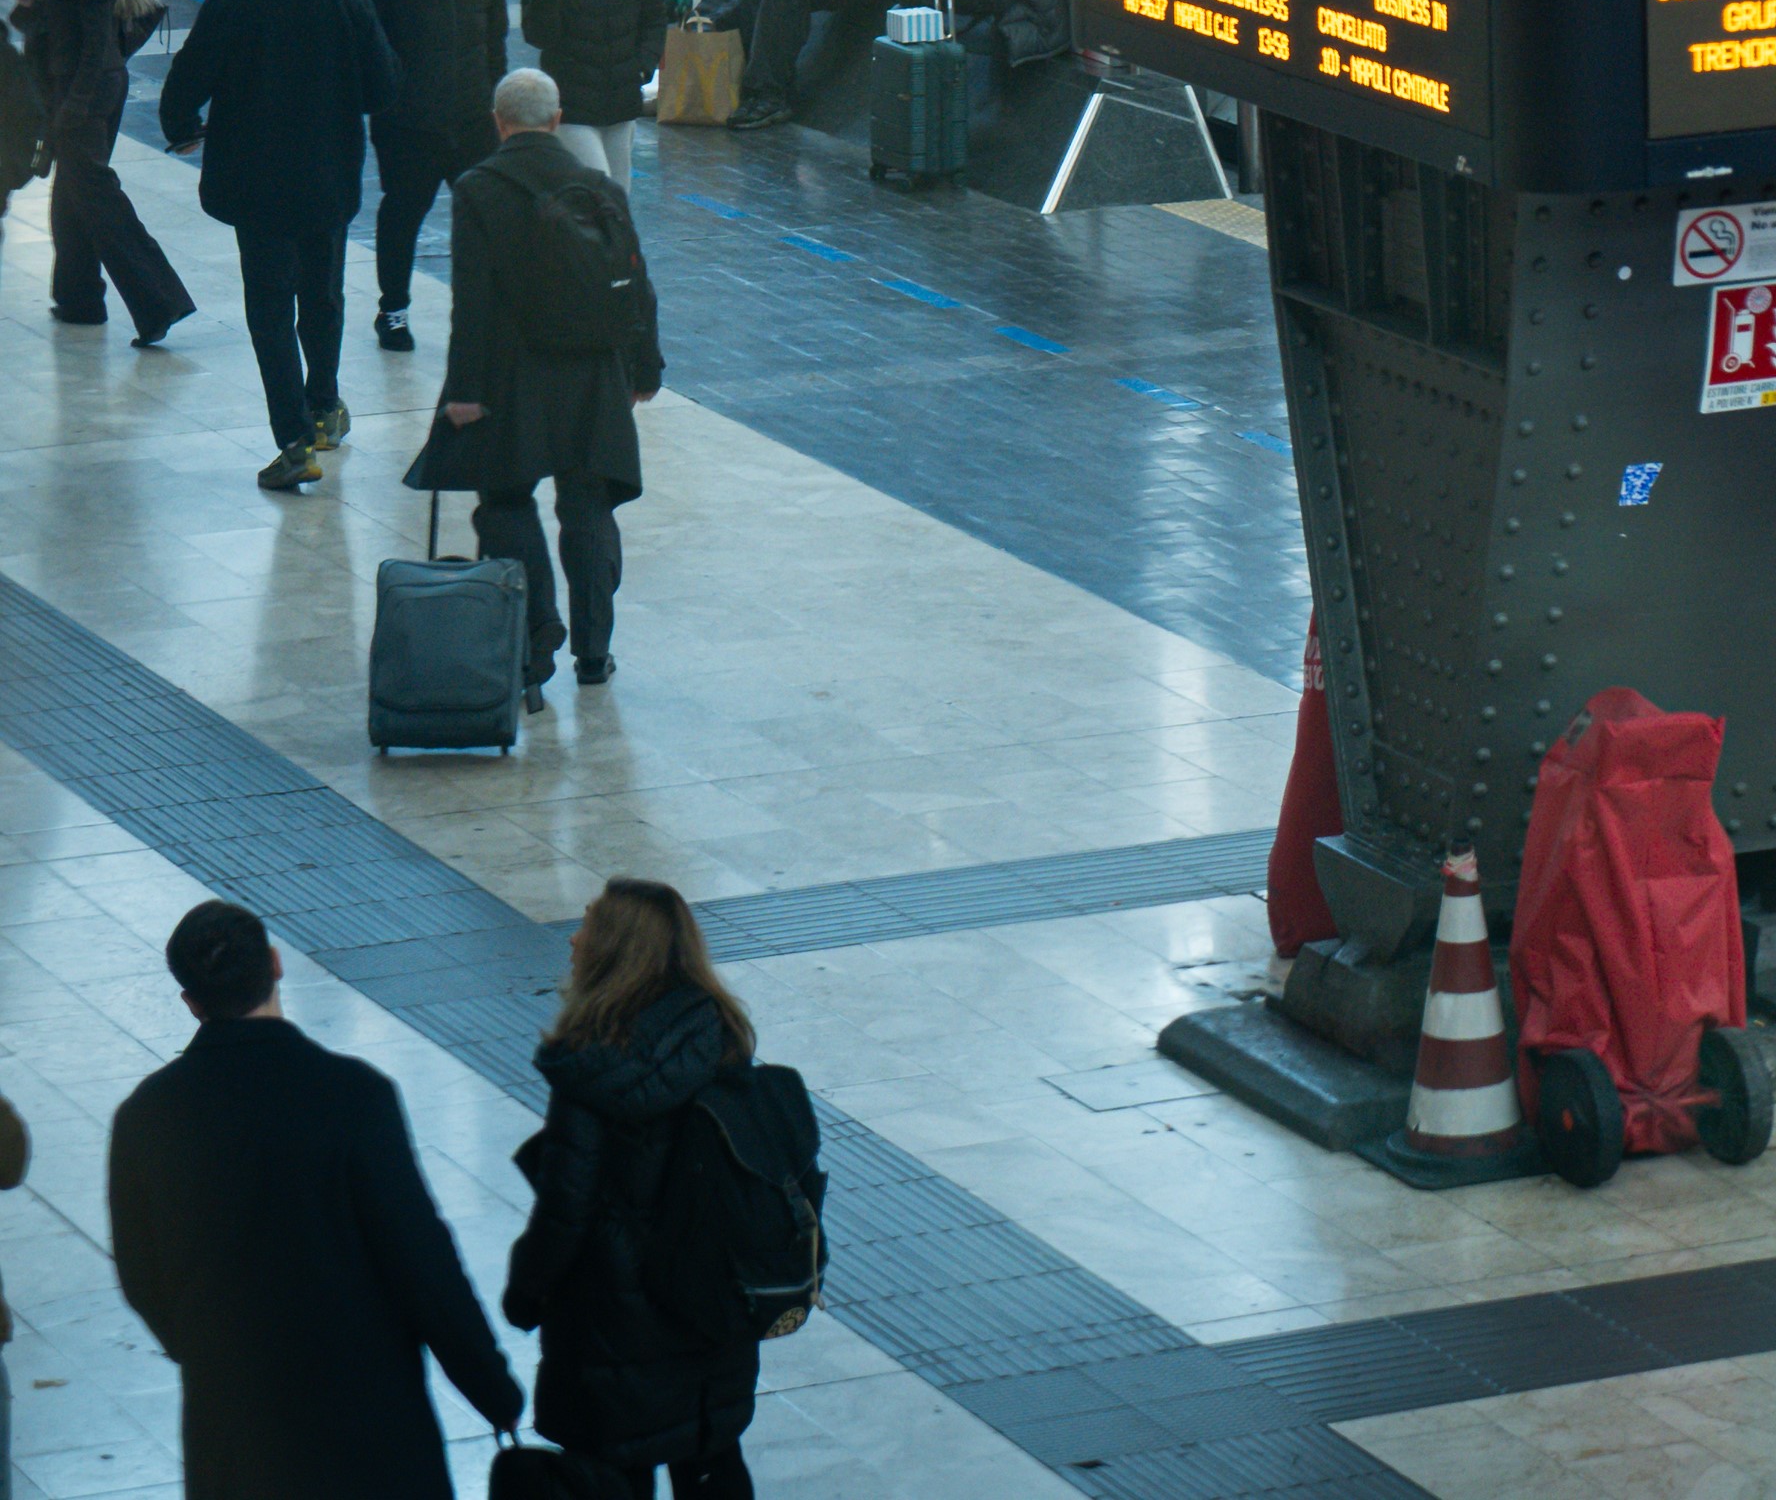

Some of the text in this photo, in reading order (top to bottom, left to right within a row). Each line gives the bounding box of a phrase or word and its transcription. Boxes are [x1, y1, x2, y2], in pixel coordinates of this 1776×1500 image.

[1317, 6, 1387, 53] CANCELLATO
[1431, 0, 1448, 31] IN
[1174, 0, 1449, 113] NAPOLI NAPOLI CENTRALE
[1751, 221, 1768, 230] No
